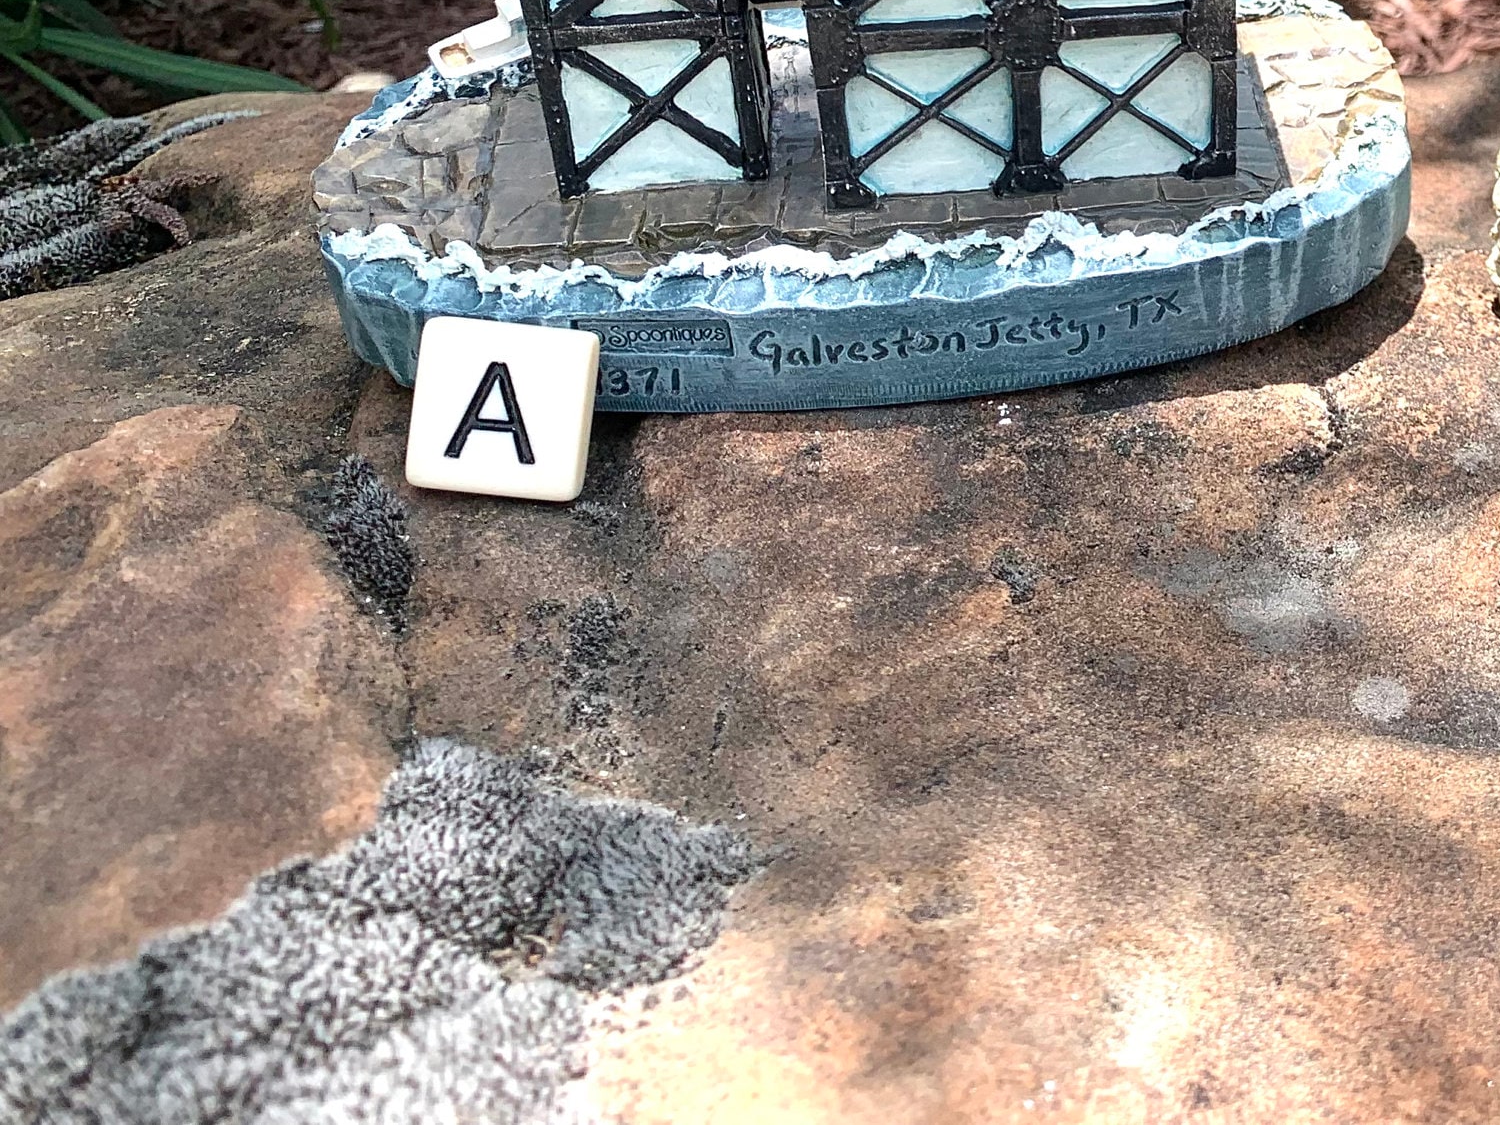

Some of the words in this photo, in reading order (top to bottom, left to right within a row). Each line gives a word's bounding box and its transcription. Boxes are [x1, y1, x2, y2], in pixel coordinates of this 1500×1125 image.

[750, 325, 967, 375] Galveston
[974, 311, 1106, 355] Jetty,
[1116, 288, 1183, 329] TX
[443, 361, 536, 465] A
